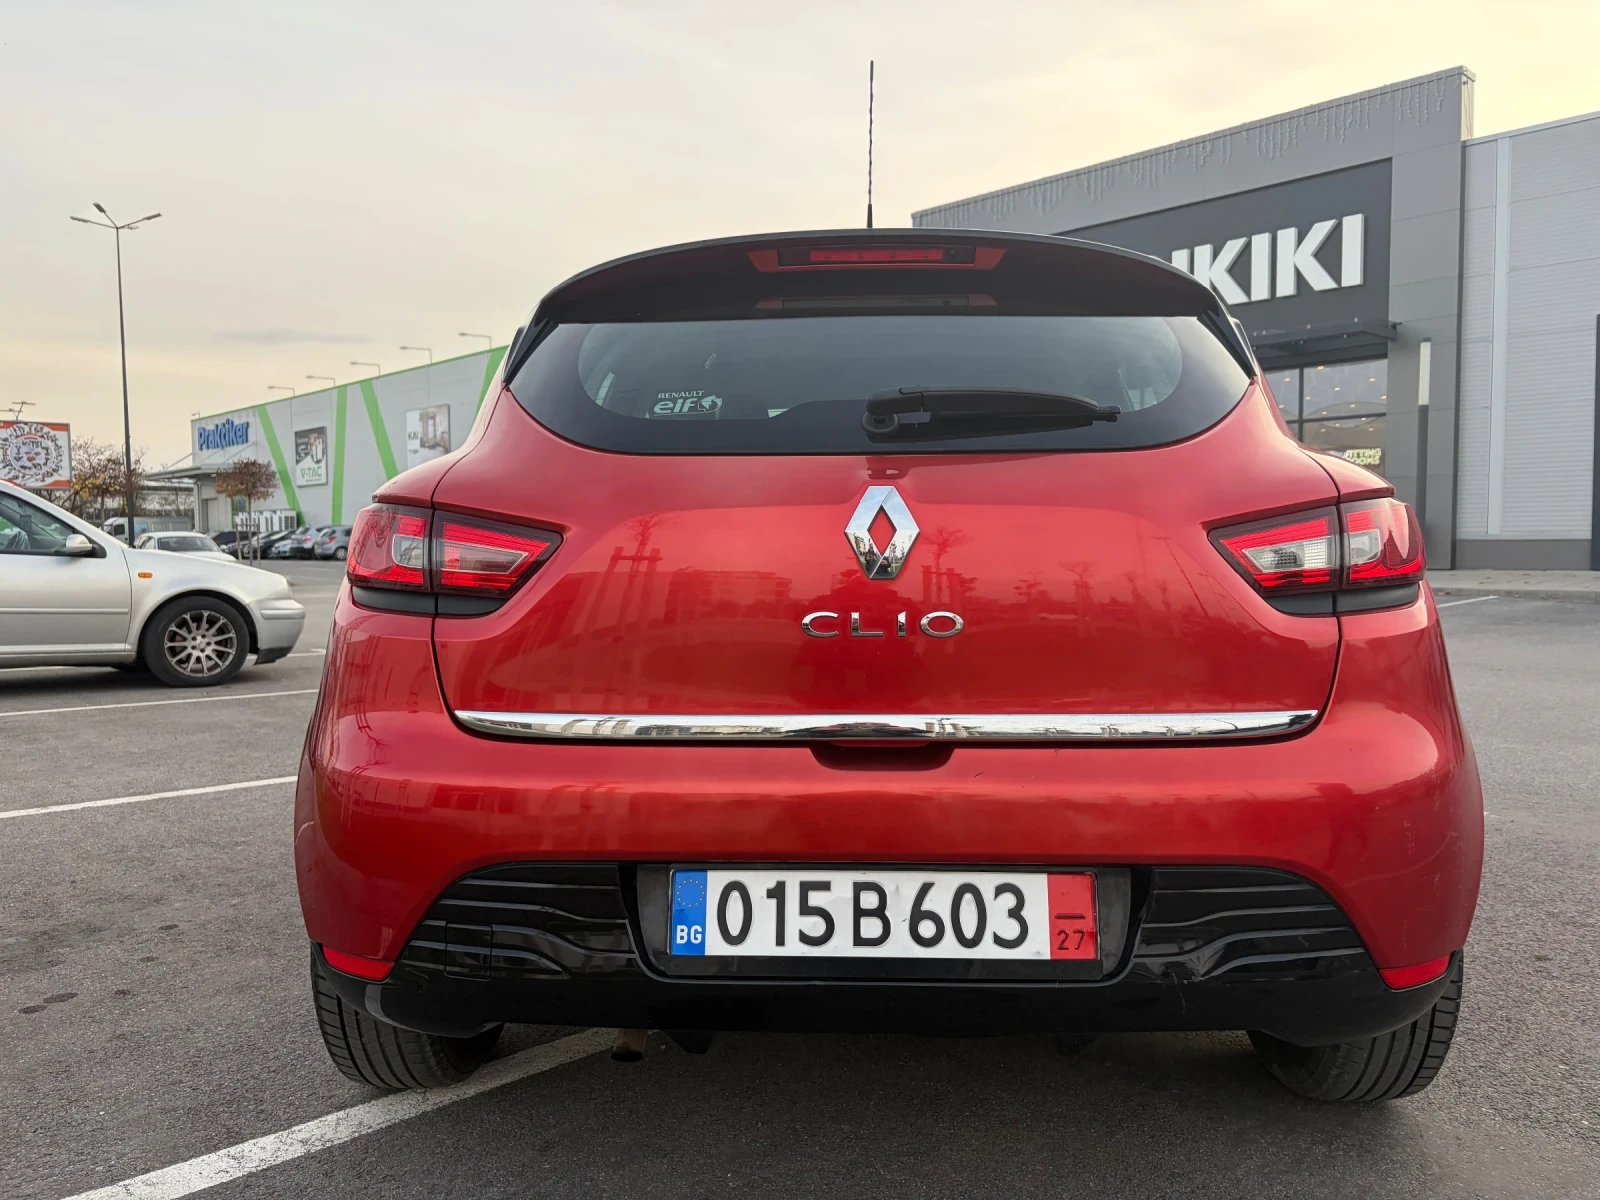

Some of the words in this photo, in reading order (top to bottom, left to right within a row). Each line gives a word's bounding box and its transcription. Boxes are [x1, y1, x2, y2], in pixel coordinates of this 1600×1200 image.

[653, 397, 698, 413] elf
[658, 390, 704, 399] RENAULT
[198, 418, 250, 452] Praktiker
[801, 610, 964, 638] CLIO
[717, 880, 835, 947] 015
[852, 881, 892, 947] B
[909, 881, 1029, 950] 603
[676, 924, 702, 945] BG
[1057, 928, 1086, 951] 27
